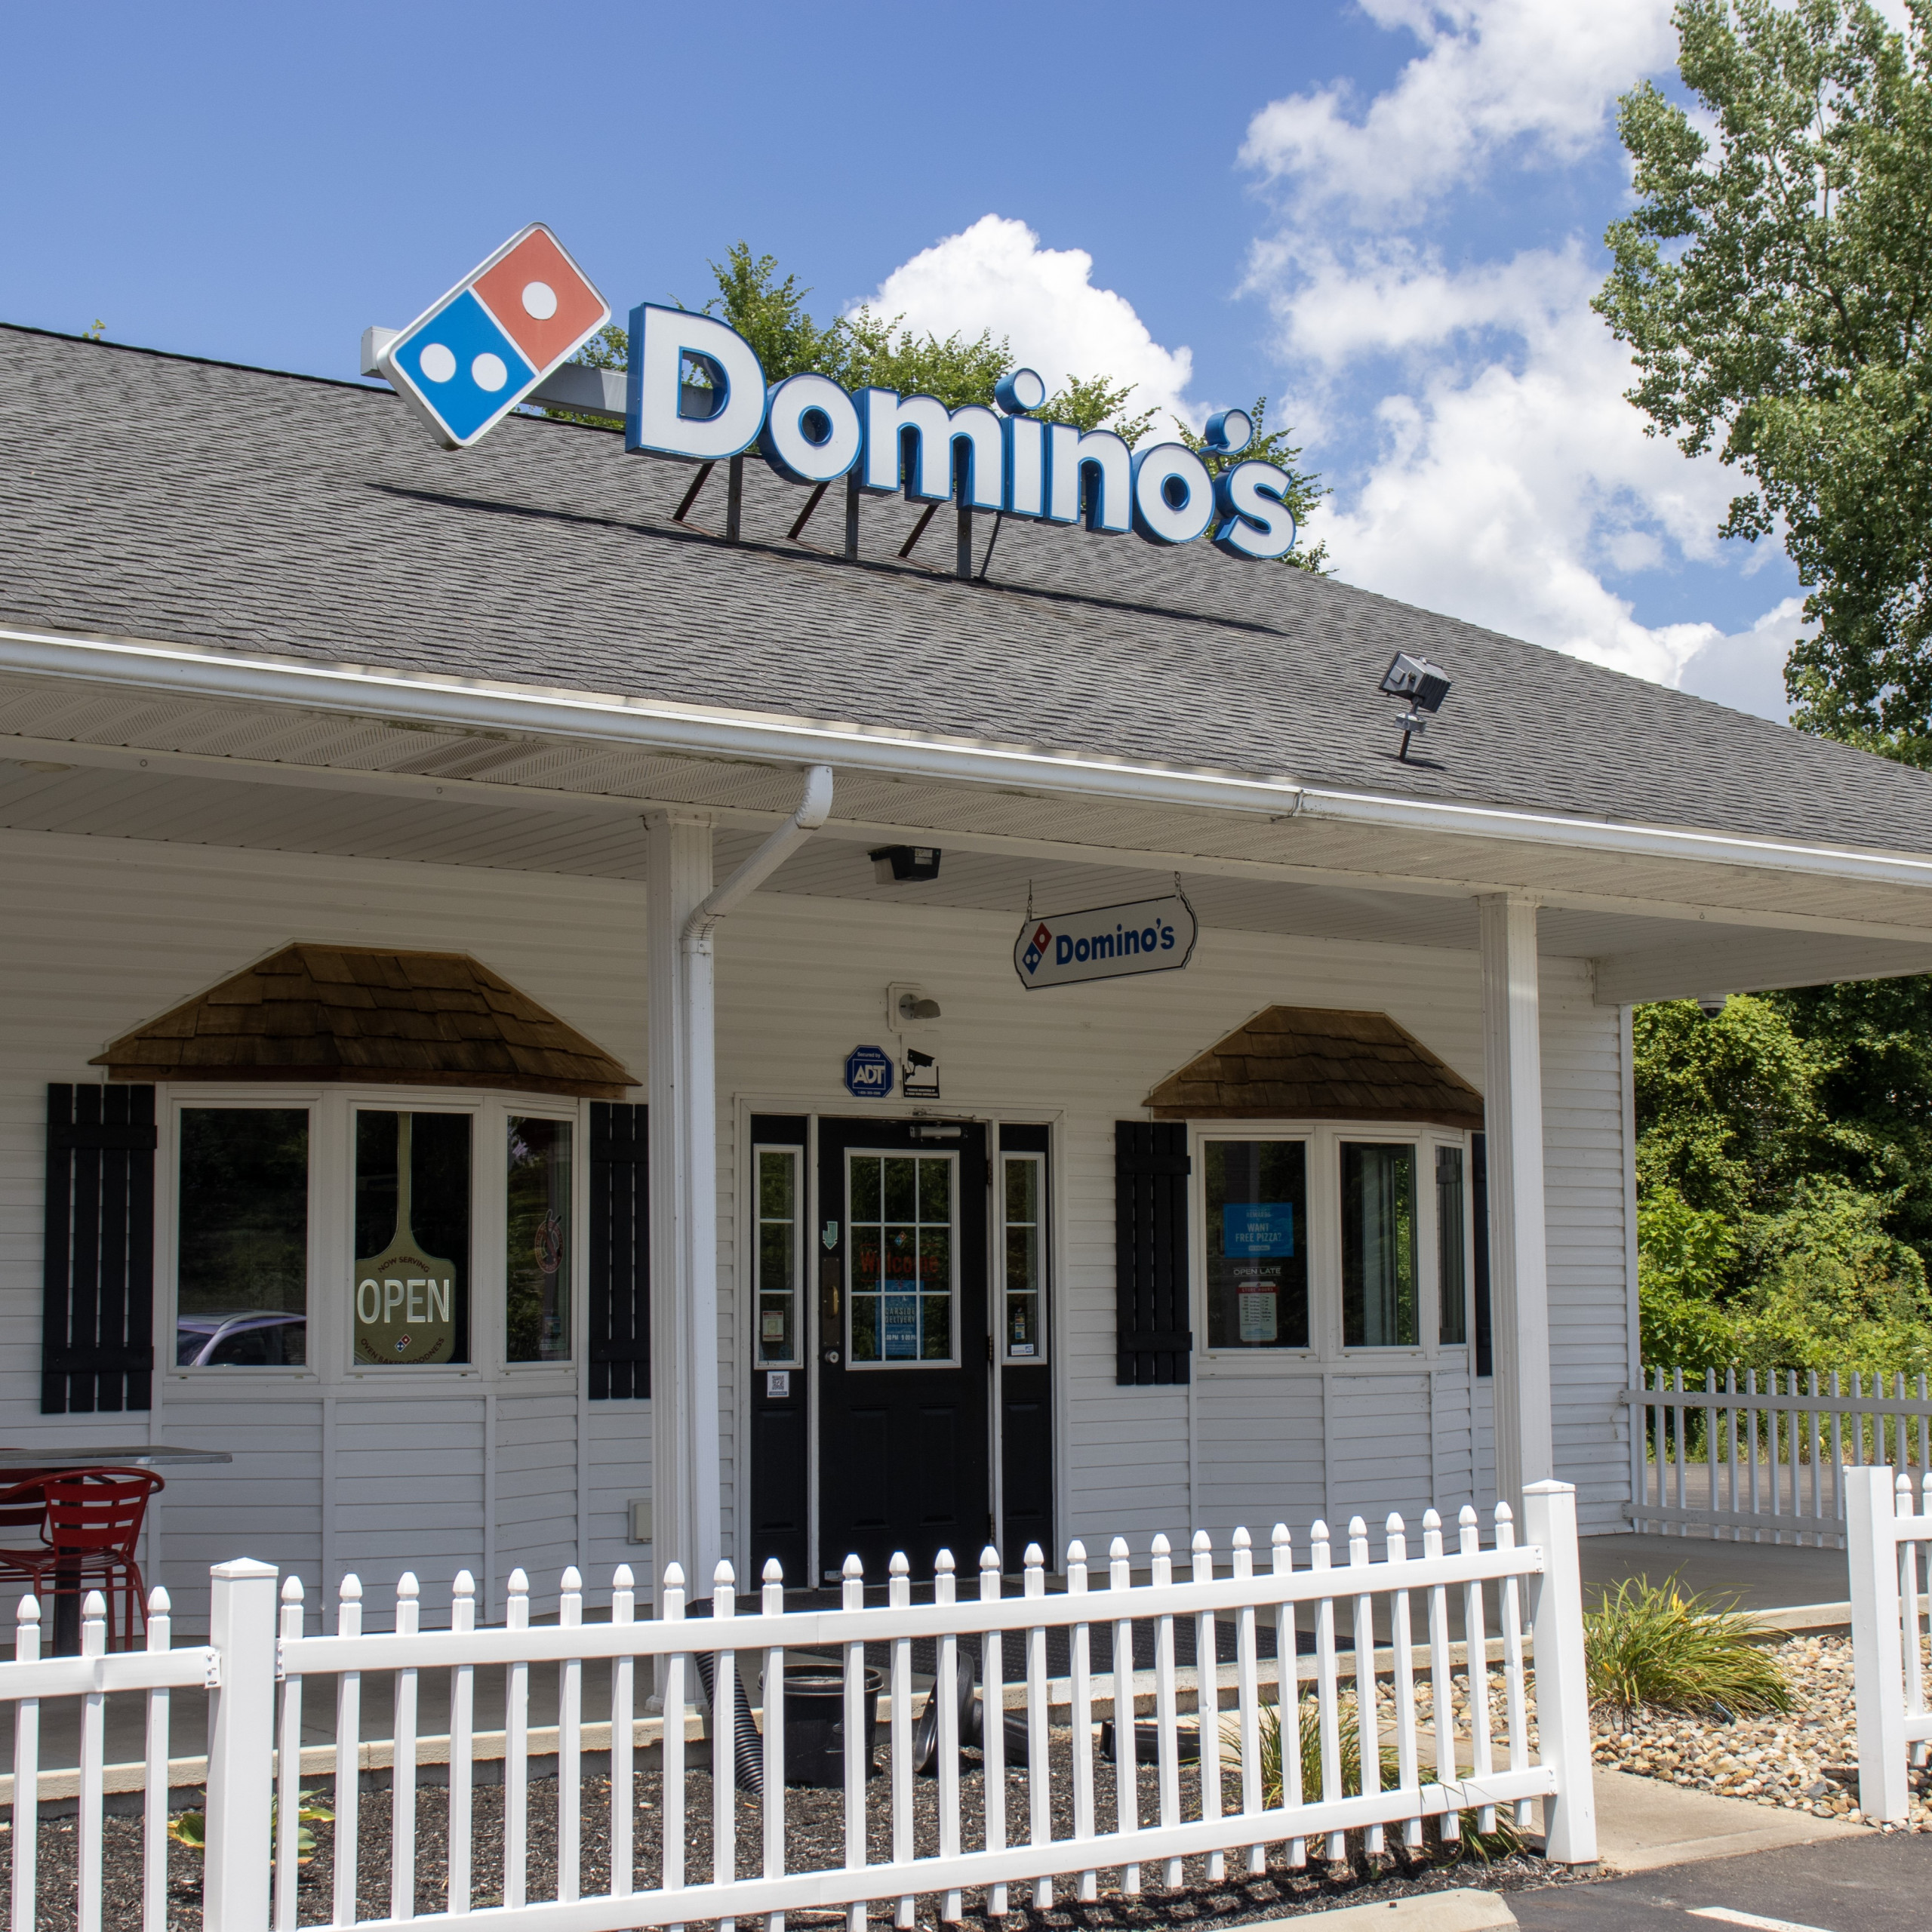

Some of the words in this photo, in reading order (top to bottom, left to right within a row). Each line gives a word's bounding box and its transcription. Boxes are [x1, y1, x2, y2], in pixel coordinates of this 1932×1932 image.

[625, 302, 1297, 559] Domino's
[1056, 918, 1175, 965] Domino's
[853, 1065, 885, 1084] ADT
[1235, 1233, 1254, 1242] FREE
[1257, 1232, 1282, 1242] PIZZA?
[1247, 1223, 1269, 1232] WANT
[377, 1257, 397, 1273] NOW
[398, 1256, 430, 1273] SERVING
[357, 1278, 450, 1324] OPEN
[361, 1338, 379, 1359] OVEN
